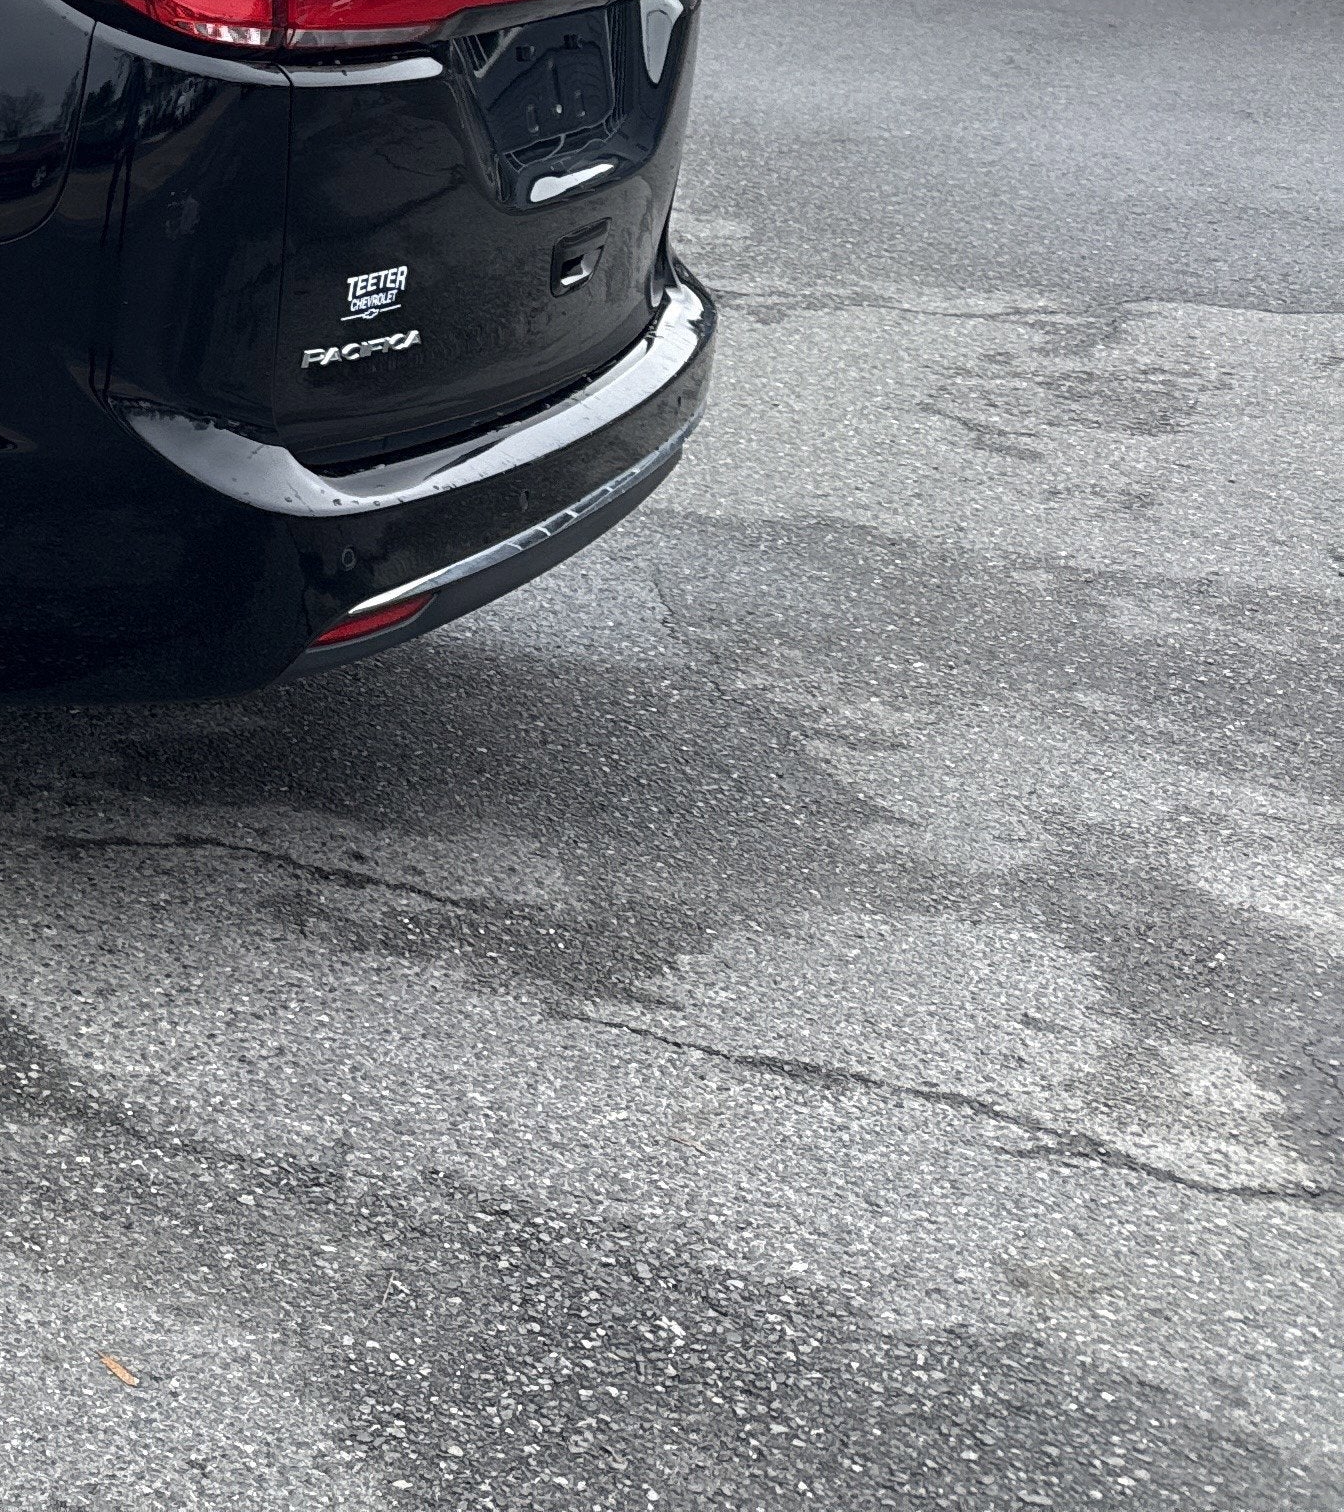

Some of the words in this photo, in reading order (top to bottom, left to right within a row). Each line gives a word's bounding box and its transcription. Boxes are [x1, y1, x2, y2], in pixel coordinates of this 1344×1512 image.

[346, 265, 408, 301] TEETER
[350, 289, 398, 312] CHEVROLET
[300, 329, 422, 369] PACIFICA
